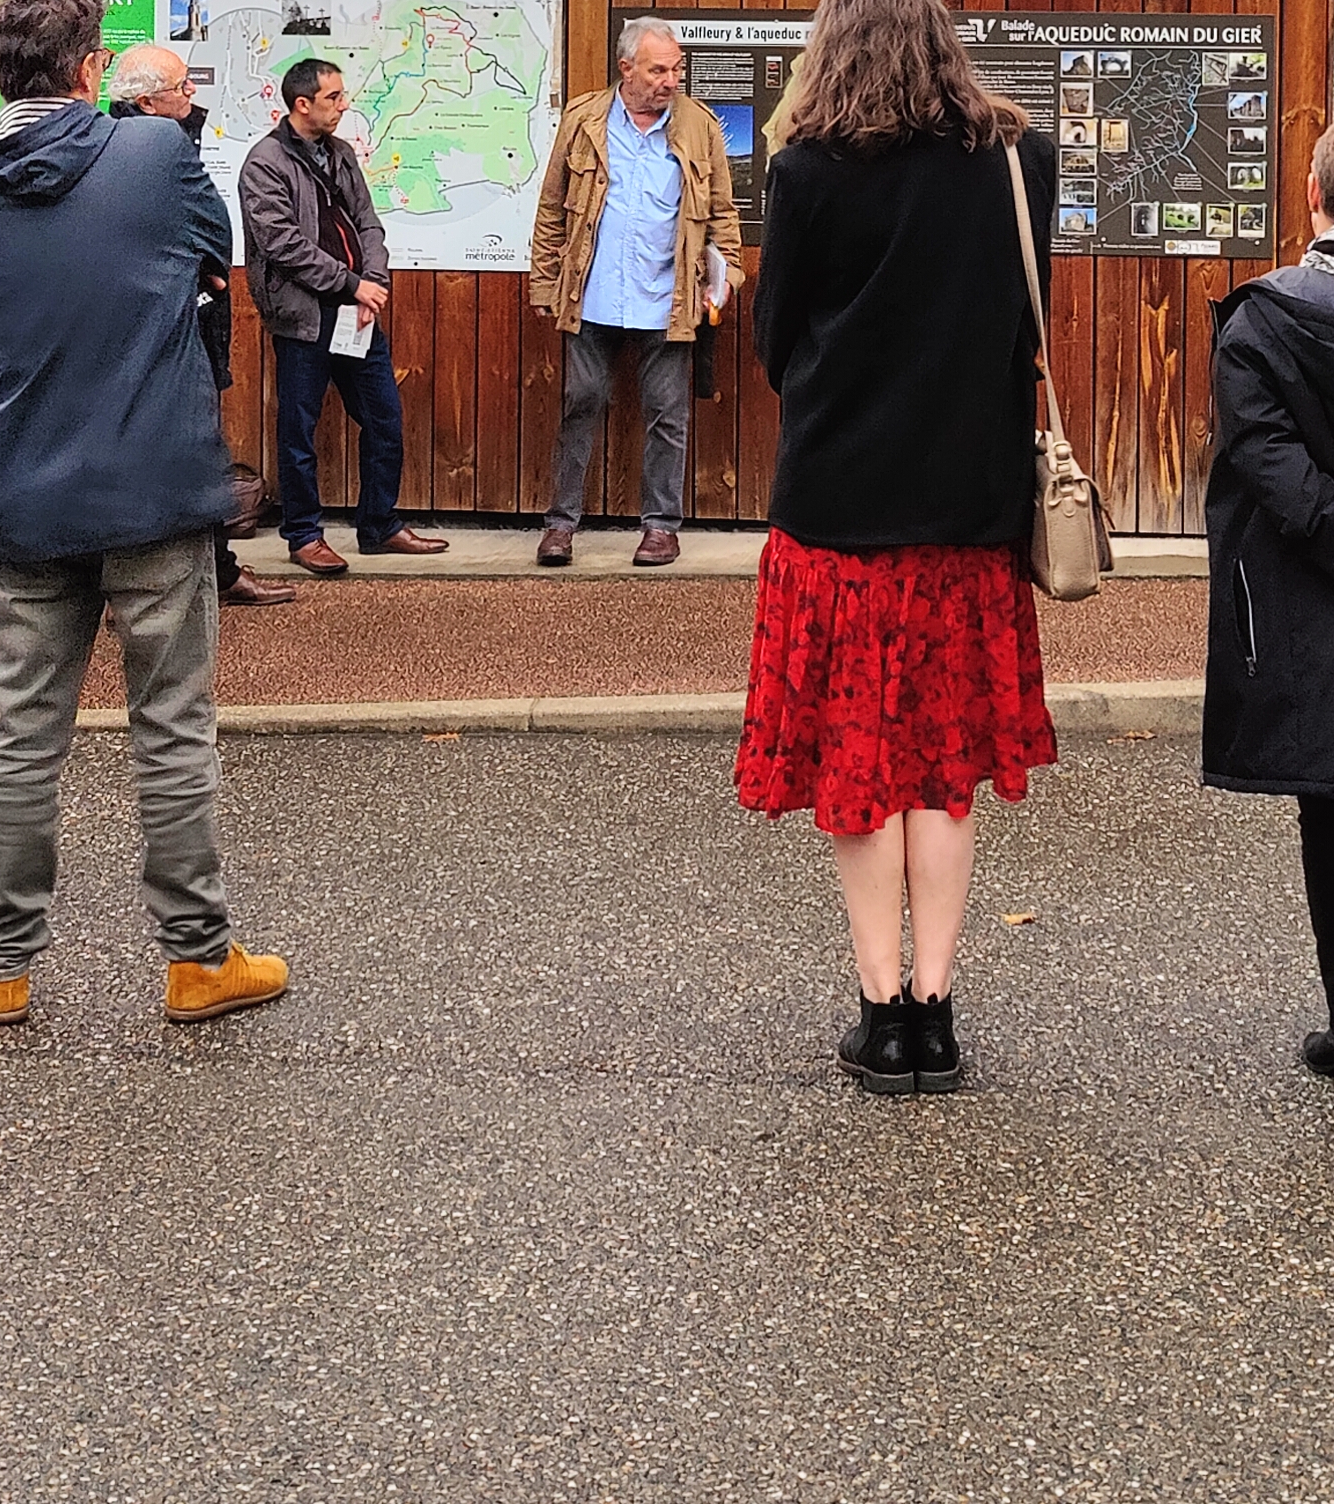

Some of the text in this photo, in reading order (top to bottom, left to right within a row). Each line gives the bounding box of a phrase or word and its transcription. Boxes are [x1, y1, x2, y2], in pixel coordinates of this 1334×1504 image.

[1001, 19, 1035, 31] Balade
[681, 26, 731, 42] Valfleury
[735, 27, 744, 39] &
[748, 27, 802, 42] l'aqueduc
[1009, 33, 1026, 42] sur
[1120, 26, 1189, 43] ROMAIN
[1193, 27, 1218, 43] DU
[1222, 27, 1262, 44] GIER
[465, 252, 516, 262] métropole
